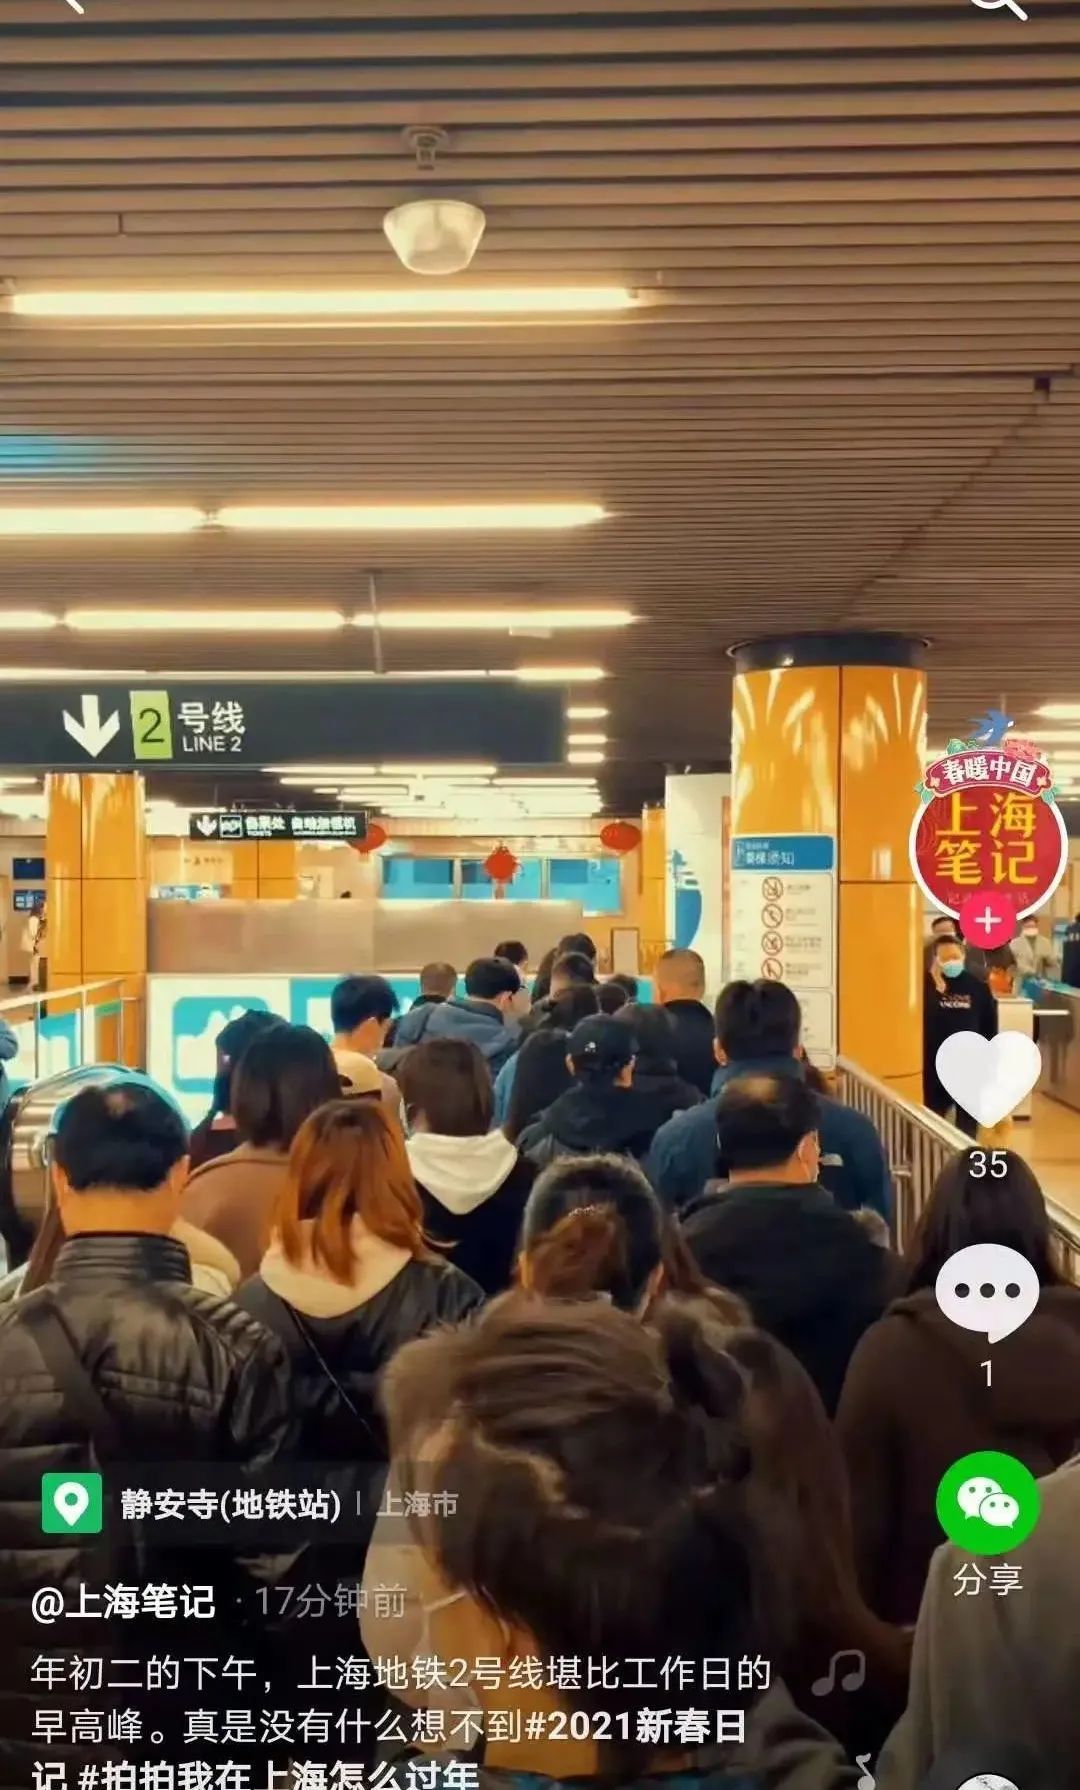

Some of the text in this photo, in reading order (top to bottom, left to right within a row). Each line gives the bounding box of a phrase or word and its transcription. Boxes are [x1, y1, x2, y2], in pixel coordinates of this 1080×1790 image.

[139, 701, 246, 743] 2 号线
[182, 736, 243, 752] LINE 2
